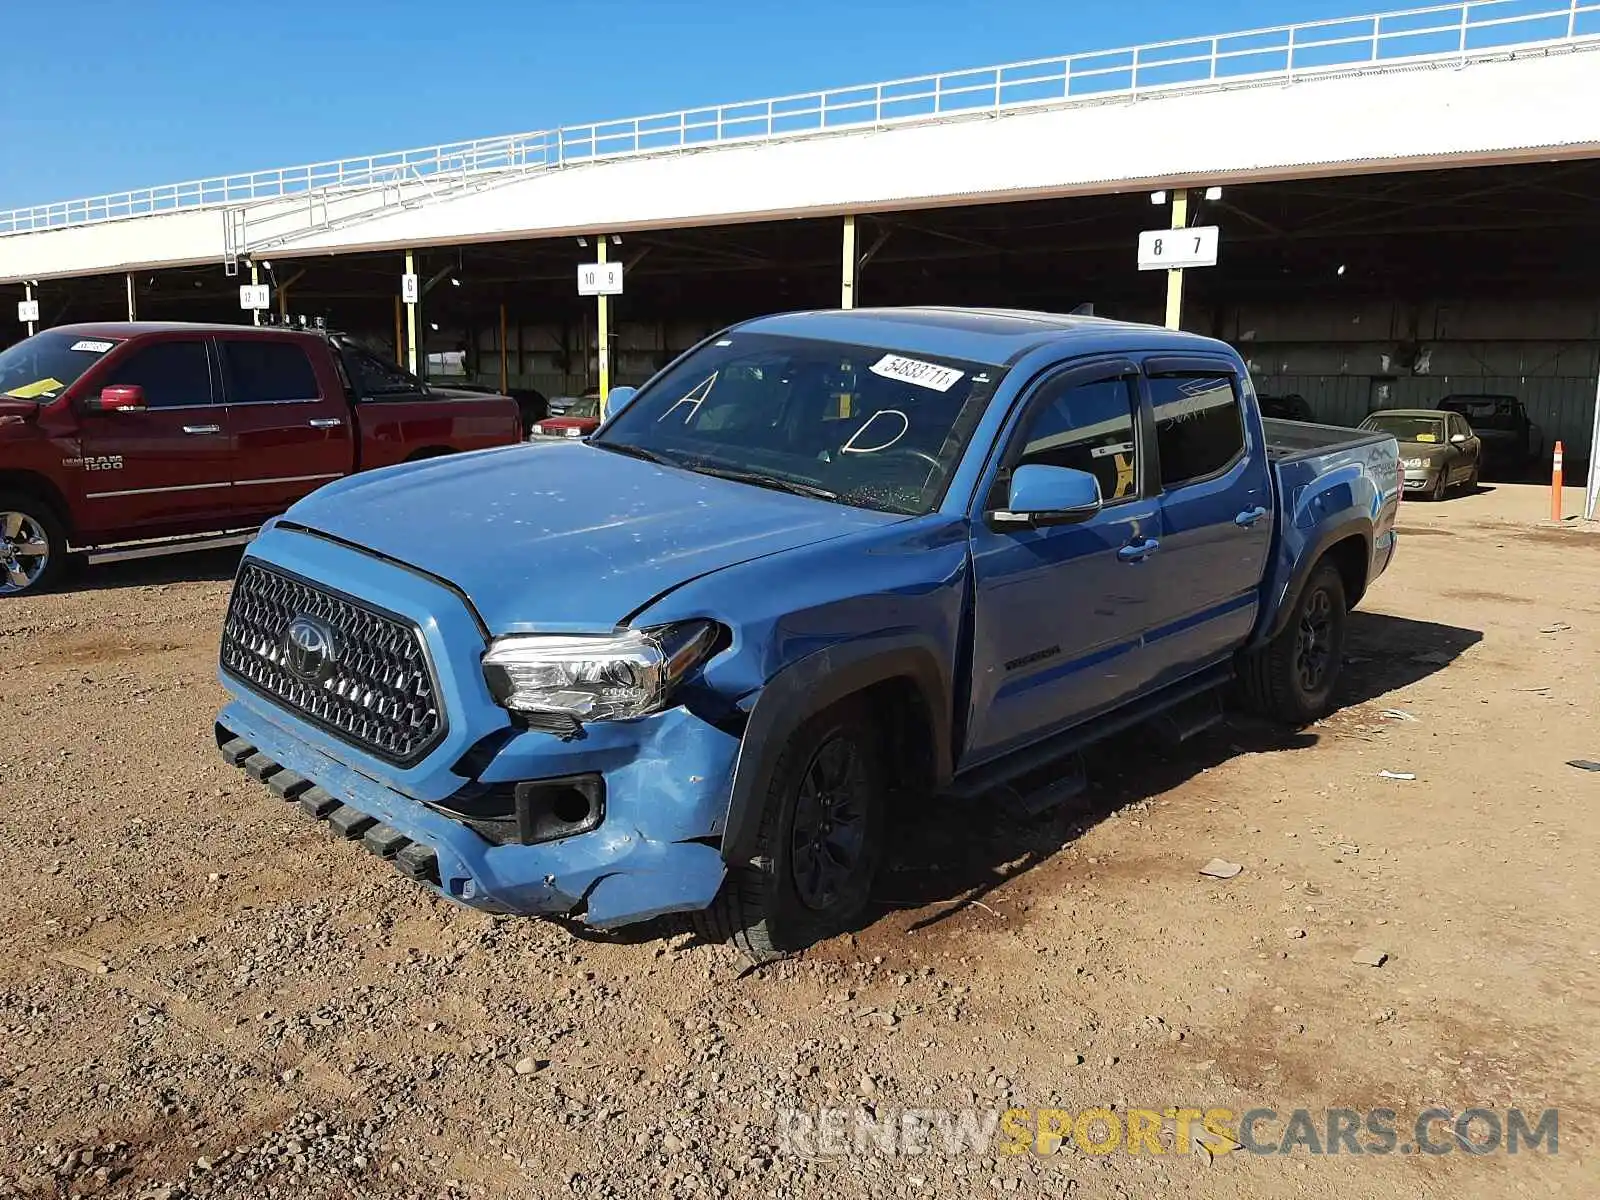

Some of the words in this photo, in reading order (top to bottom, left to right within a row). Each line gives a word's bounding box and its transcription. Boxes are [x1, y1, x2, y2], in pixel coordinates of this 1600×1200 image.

[1153, 238, 1163, 256] 8
[1193, 236, 1201, 254] 7
[585, 271, 595, 285] 10
[608, 271, 614, 285] 9
[259, 291, 265, 302] 11
[657, 370, 719, 425] A
[841, 409, 909, 455] D
[84, 455, 123, 464] RAM
[84, 462, 123, 471] 1500
